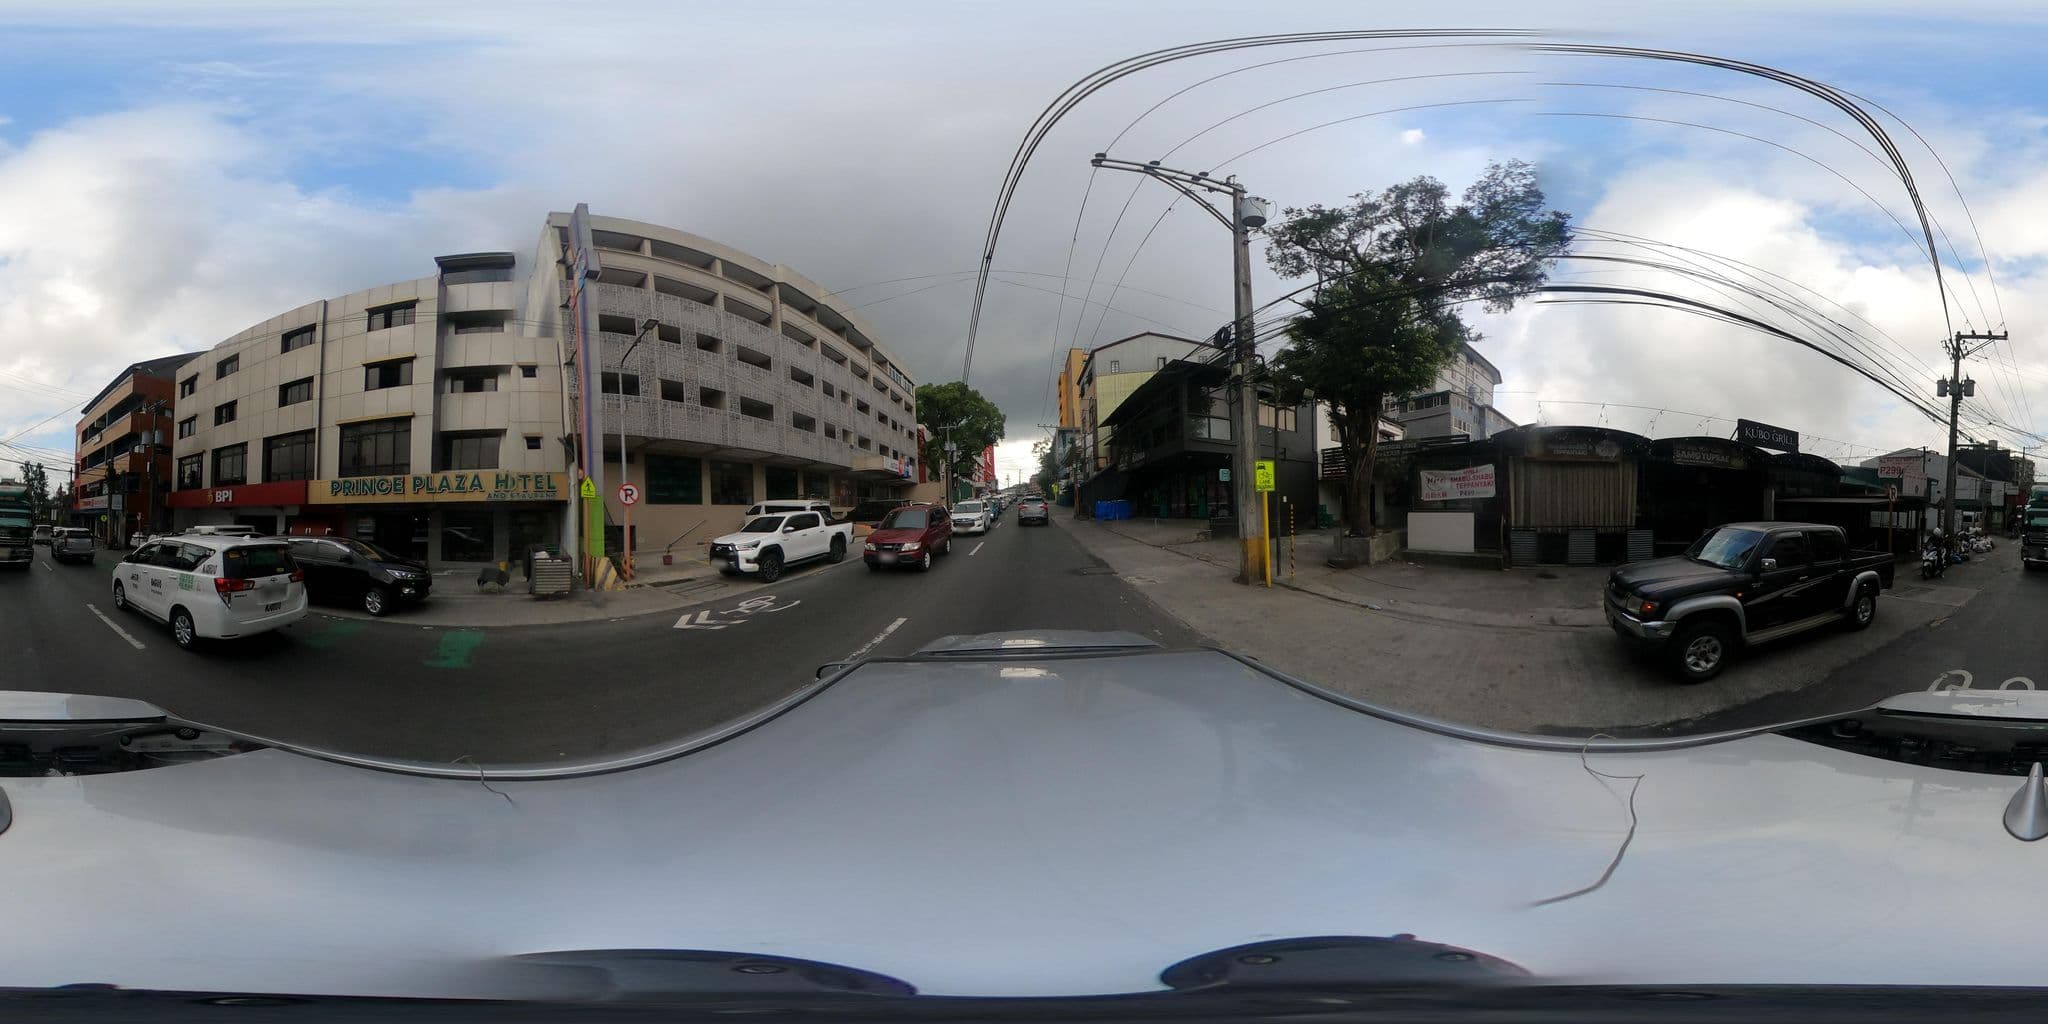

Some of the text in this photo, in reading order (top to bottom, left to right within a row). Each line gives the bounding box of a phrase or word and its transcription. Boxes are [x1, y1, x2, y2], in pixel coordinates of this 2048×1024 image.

[1744, 426, 1793, 445] KUBO GRILL
[331, 477, 405, 496] PRINCE
[412, 474, 485, 494] PLAZA
[215, 489, 233, 503] BPI
